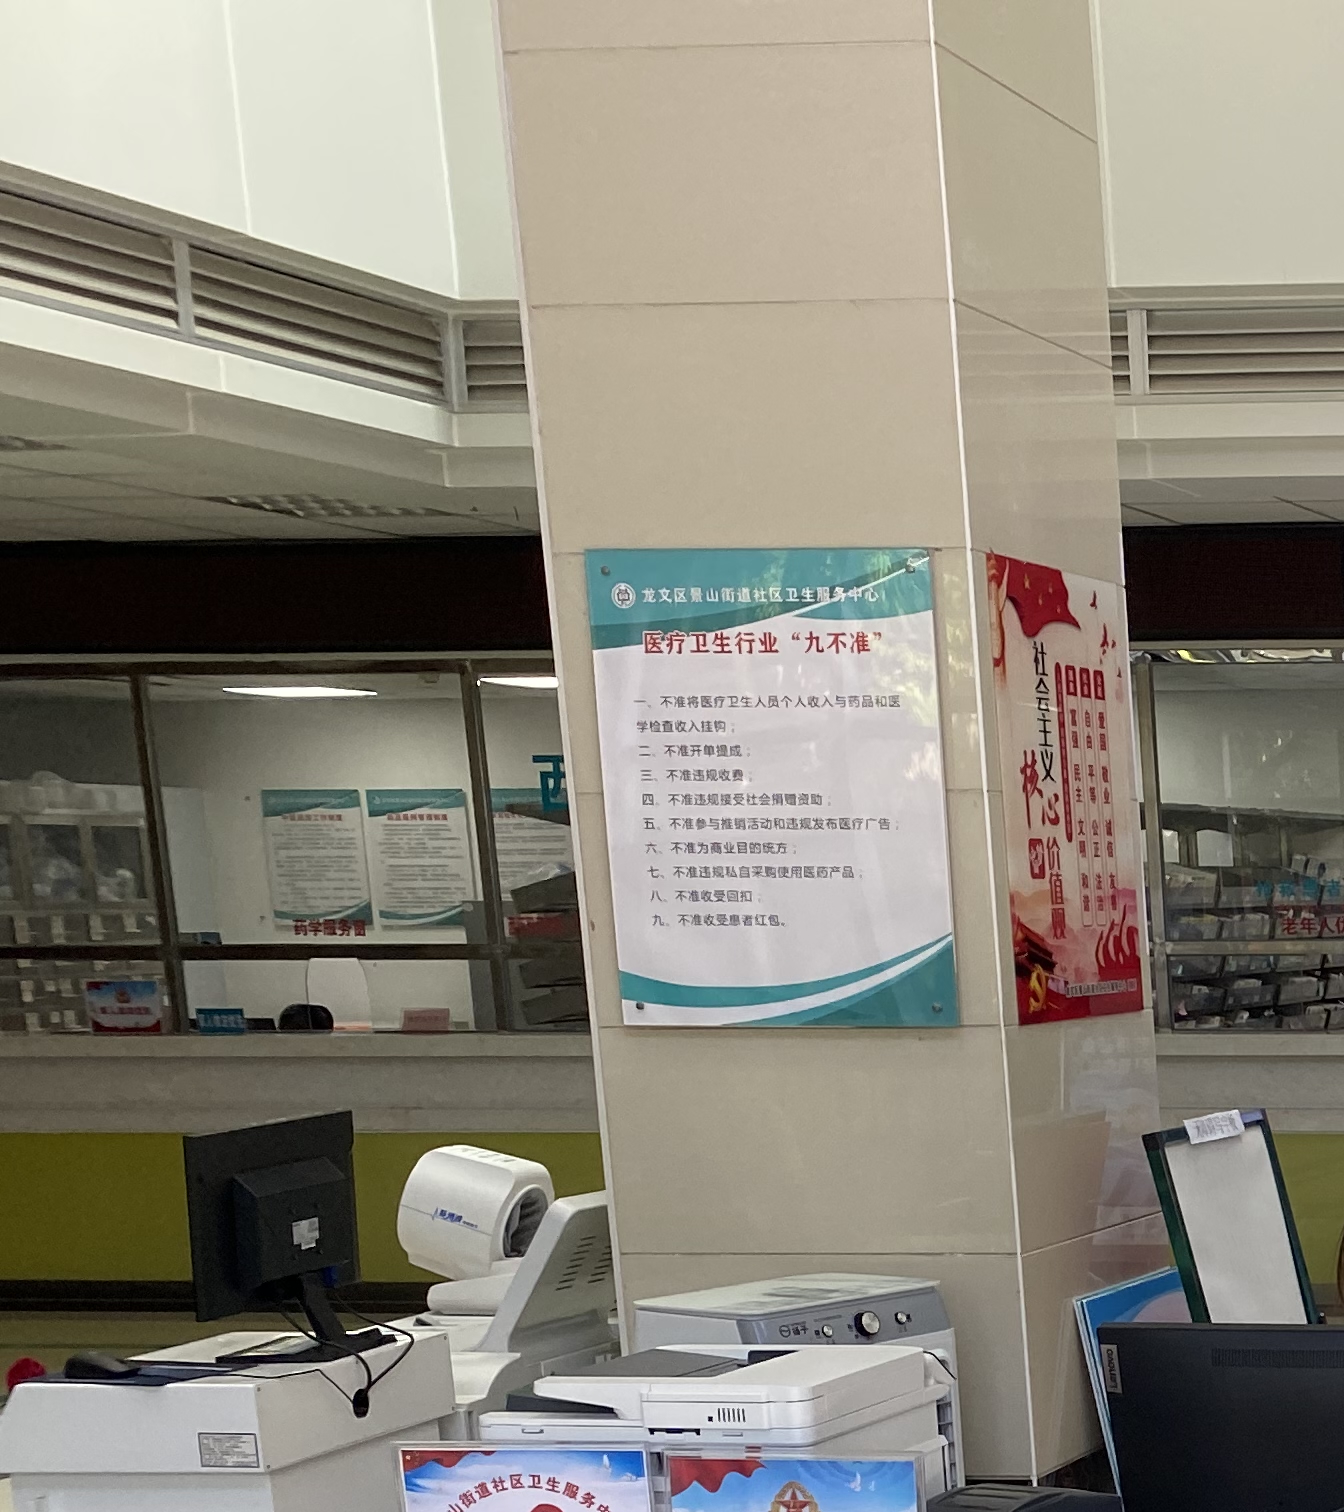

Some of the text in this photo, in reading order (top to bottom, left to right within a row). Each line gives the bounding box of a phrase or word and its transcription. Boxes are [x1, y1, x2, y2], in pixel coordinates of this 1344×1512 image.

[641, 586, 879, 604] 龙文区景山街道社区卫生服务中心
[643, 631, 882, 655] 医疗卫生行业“九不准”
[634, 695, 901, 709] 一、不准将医疗卫生人员个人收入与药品和医
[1032, 641, 1056, 783] 社会主义
[1020, 750, 1061, 831] 核心
[1046, 837, 1066, 939] 价值观
